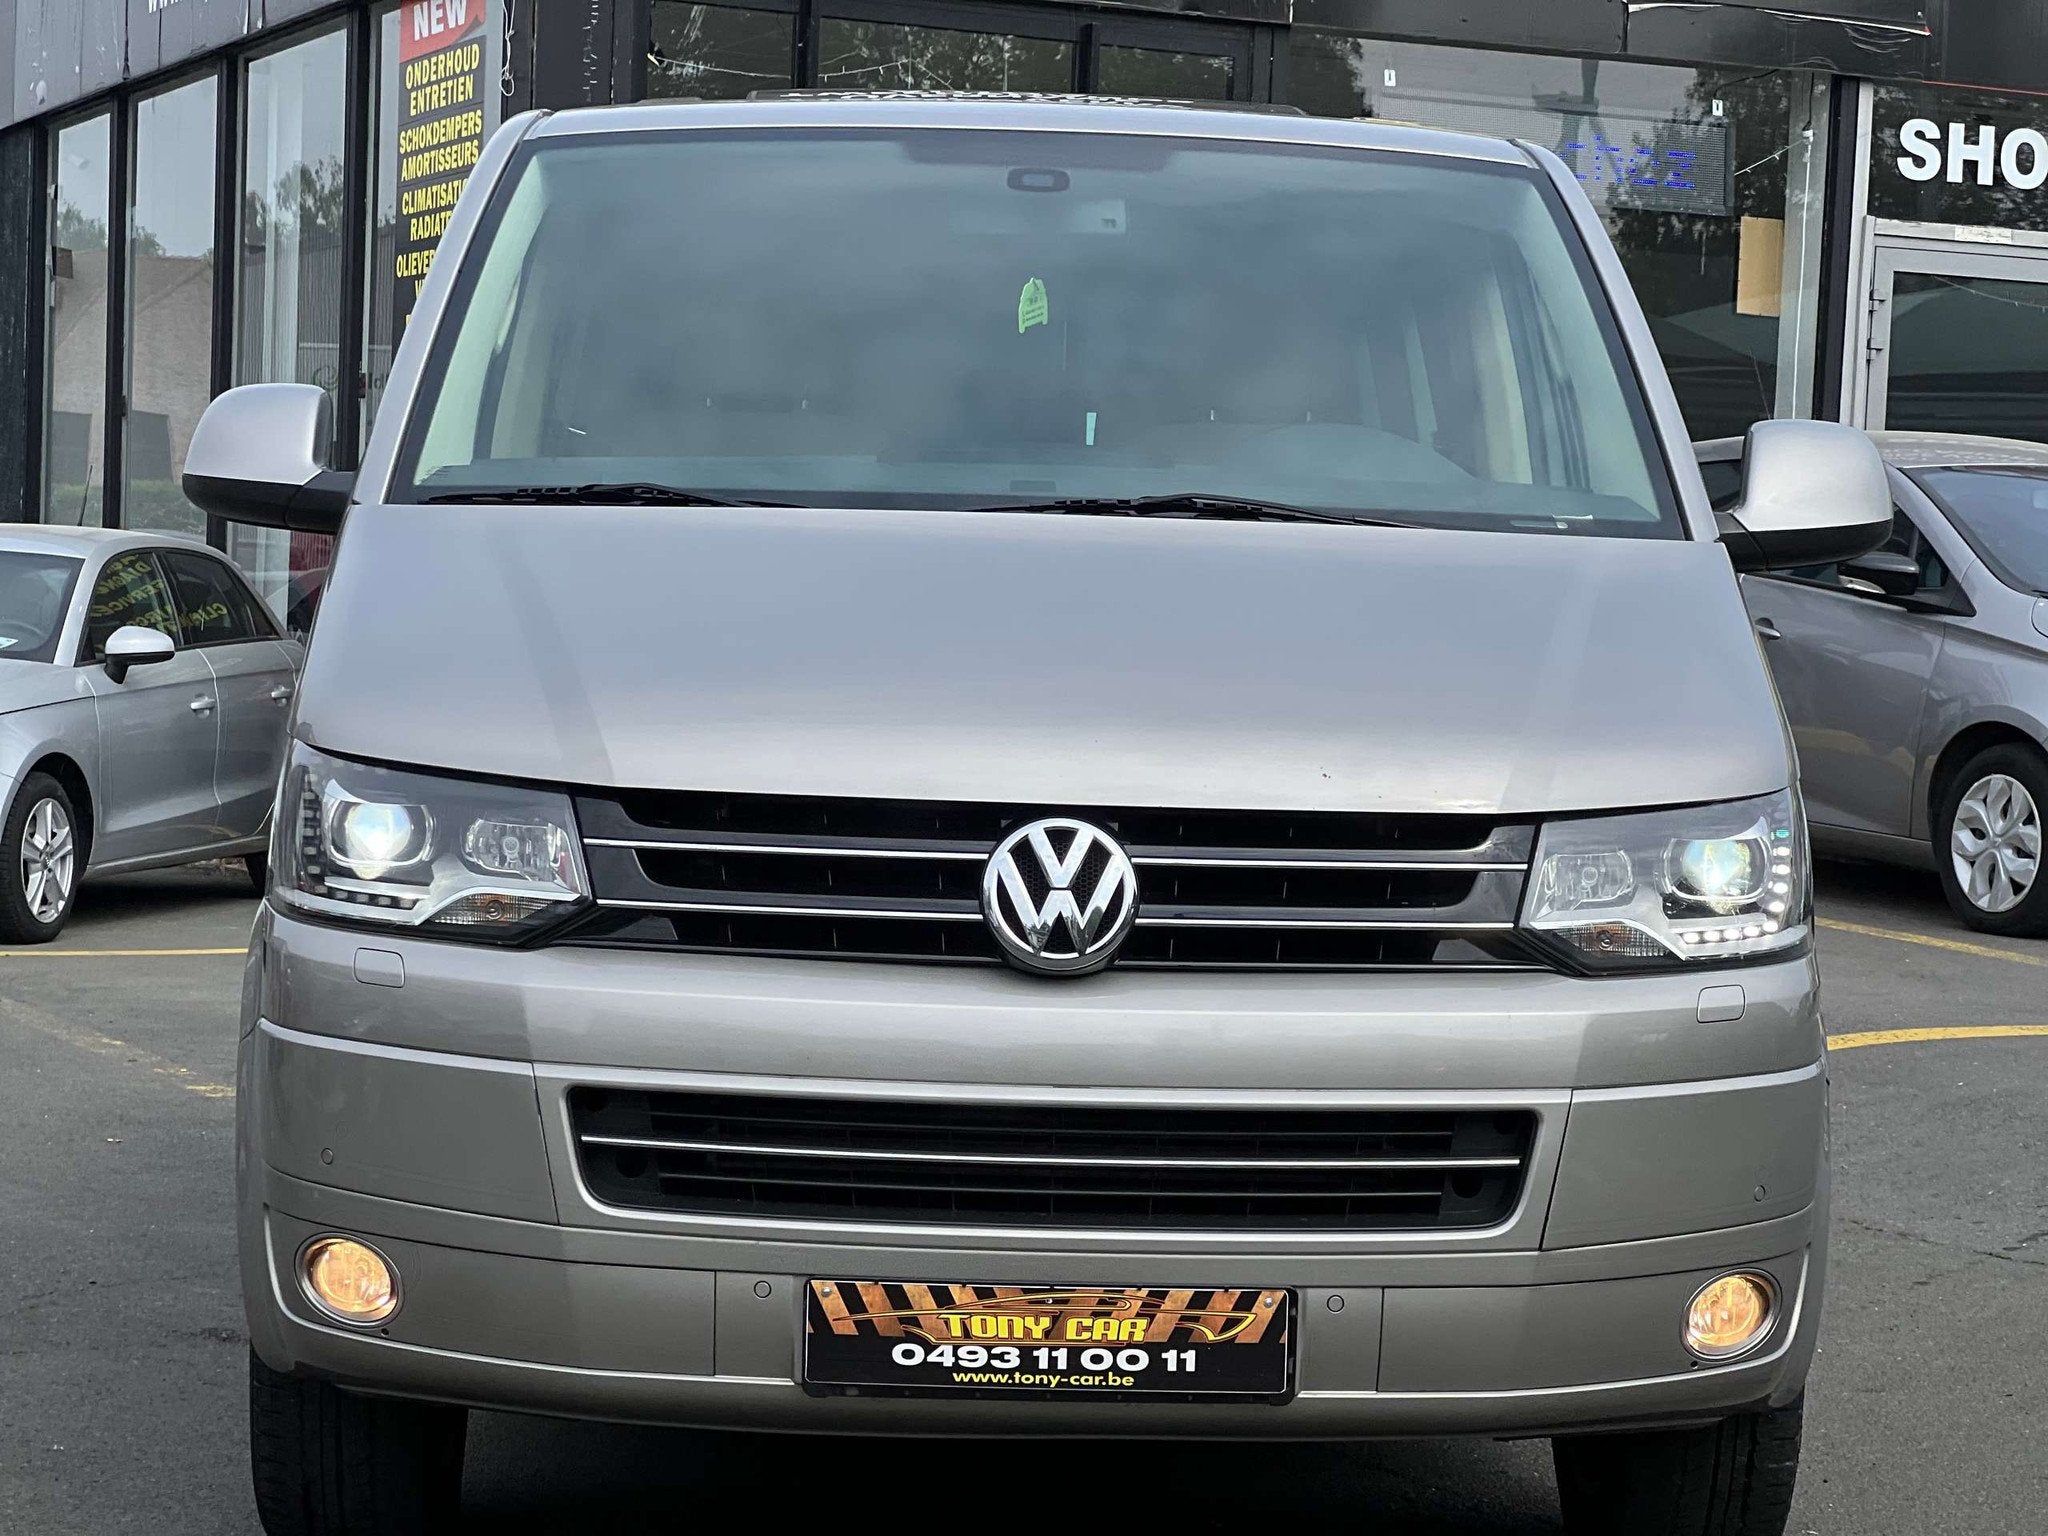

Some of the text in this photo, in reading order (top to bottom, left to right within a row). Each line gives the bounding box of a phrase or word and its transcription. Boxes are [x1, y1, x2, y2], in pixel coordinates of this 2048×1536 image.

[413, 0, 468, 41] NEW
[405, 43, 480, 90] ONDERHOUD
[410, 74, 474, 117] ENTRETIEN
[399, 109, 482, 154] SCHOKDEMPERS
[401, 139, 480, 182] AMORTISSEURS
[1897, 118, 2048, 190] SHO
[938, 1313, 1149, 1342] TONY CAR
[891, 1342, 1021, 1369] 0493
[1032, 1346, 1069, 1371] 11
[1160, 1349, 1196, 1373] 11
[952, 1370, 1136, 1388] www.tony-car.be
